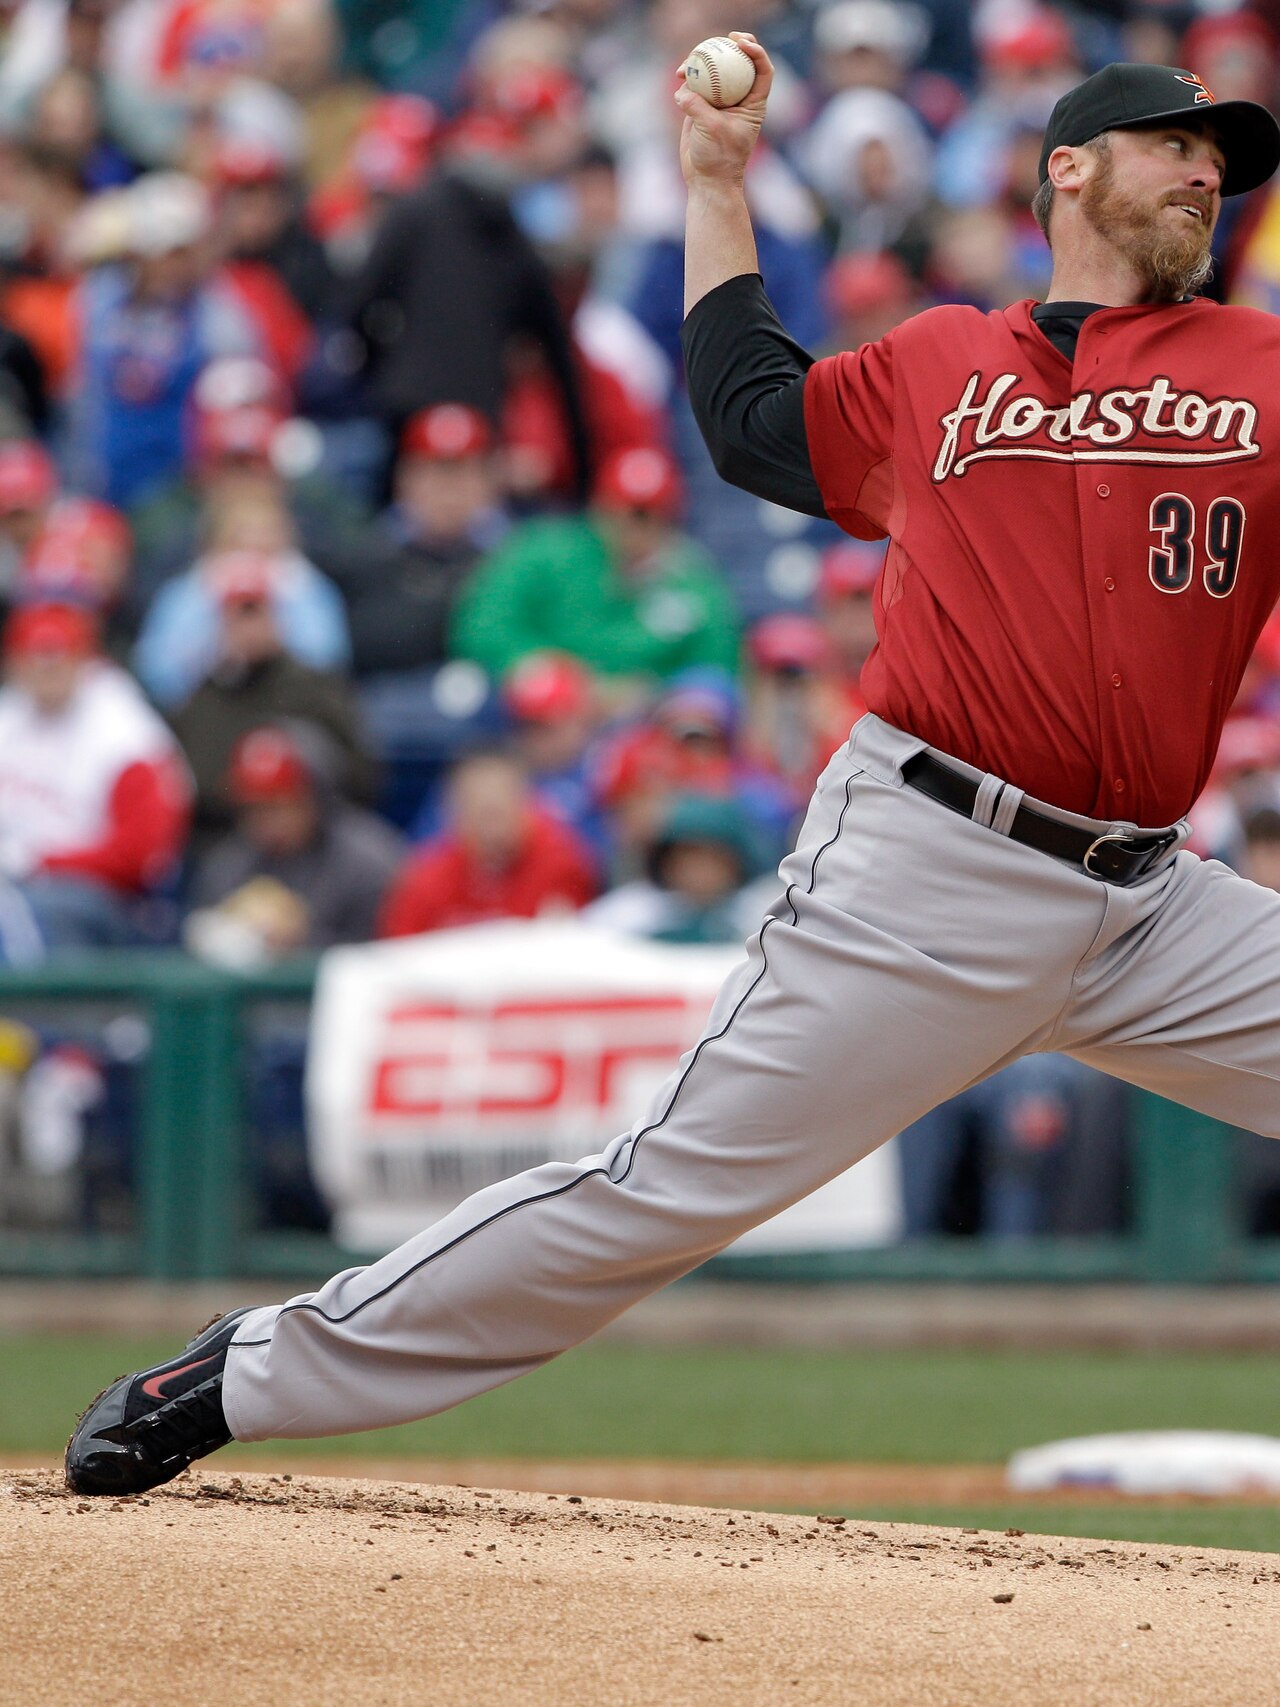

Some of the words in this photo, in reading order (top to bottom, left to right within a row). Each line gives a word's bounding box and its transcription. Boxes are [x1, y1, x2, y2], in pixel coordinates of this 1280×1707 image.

[933, 370, 1261, 484] Houston
[1149, 492, 1246, 599] 39
[368, 992, 716, 1118] ESP
